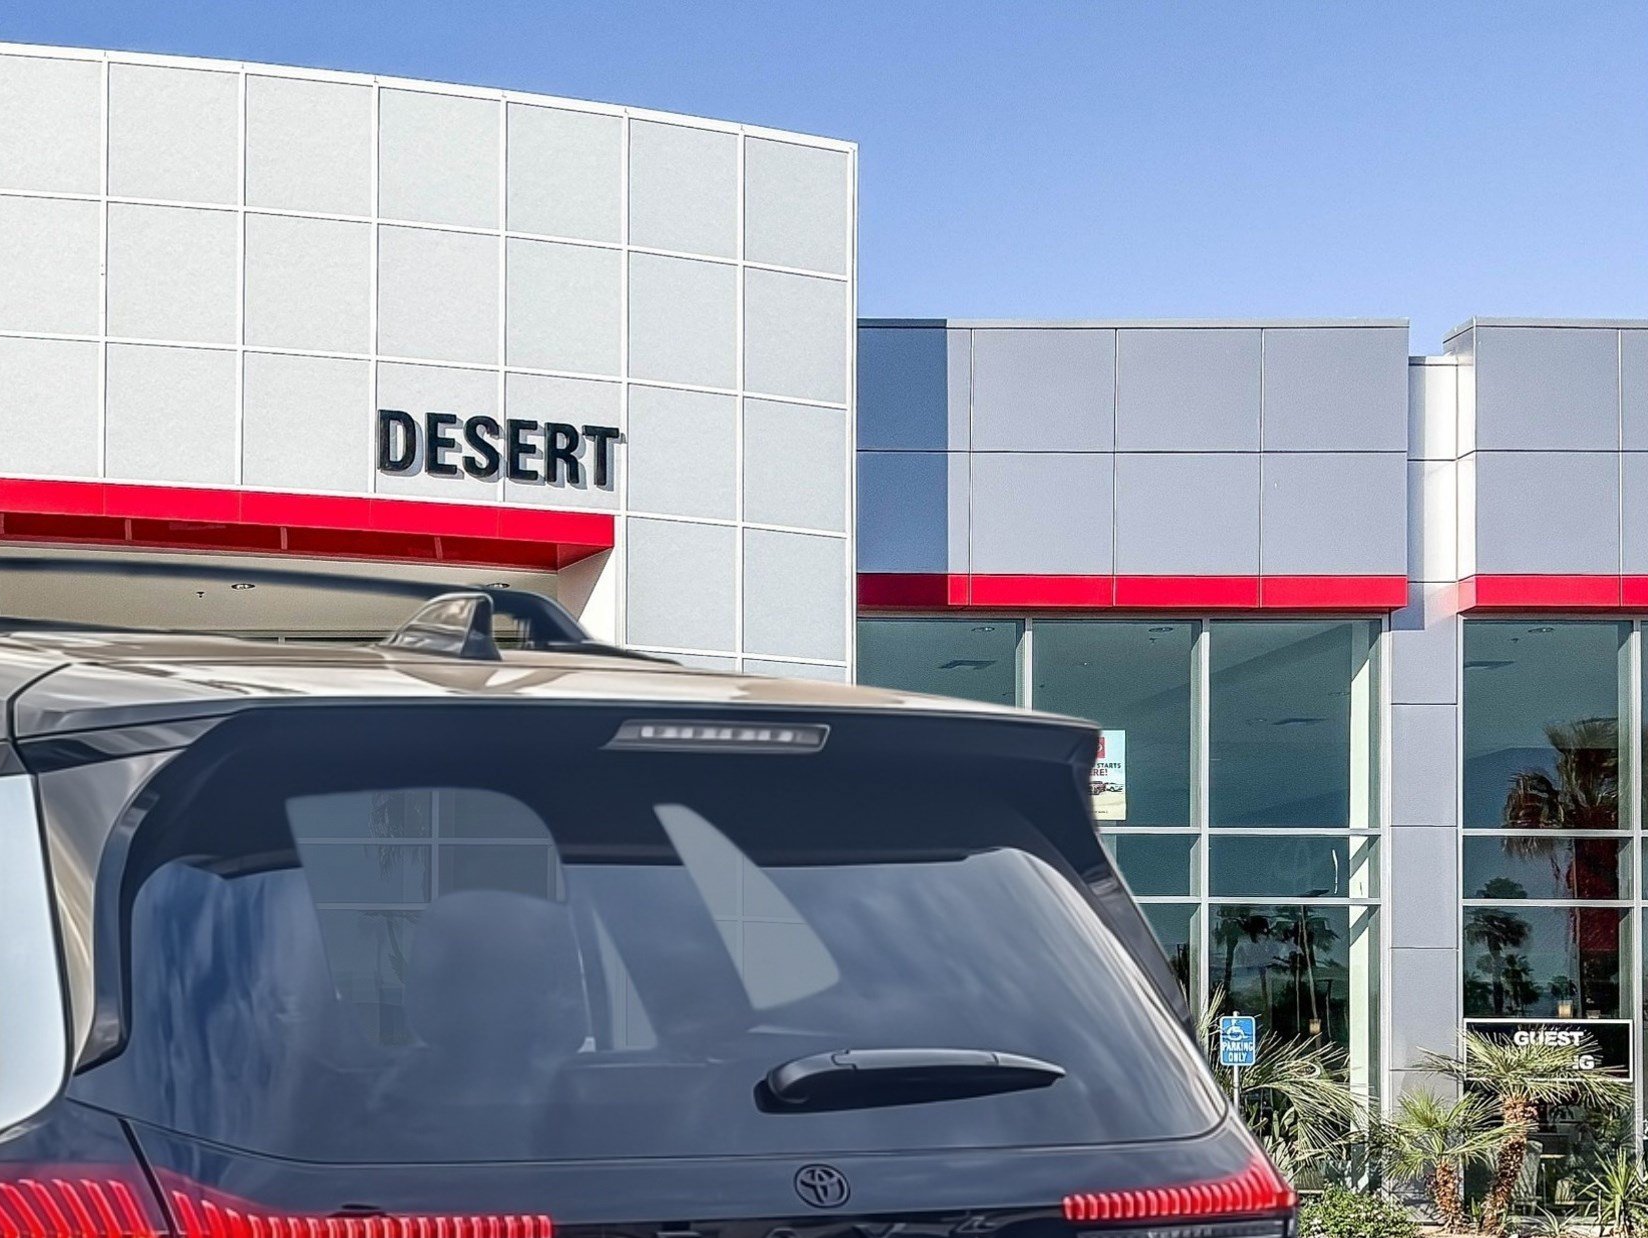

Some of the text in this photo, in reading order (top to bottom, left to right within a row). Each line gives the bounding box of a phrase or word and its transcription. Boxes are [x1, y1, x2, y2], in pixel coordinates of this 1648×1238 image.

[376, 409, 620, 487] DESERT
[1513, 1031, 1584, 1046] GUEST
[1222, 1041, 1253, 1052] PARKING
[1228, 1052, 1247, 1062] ONLY
